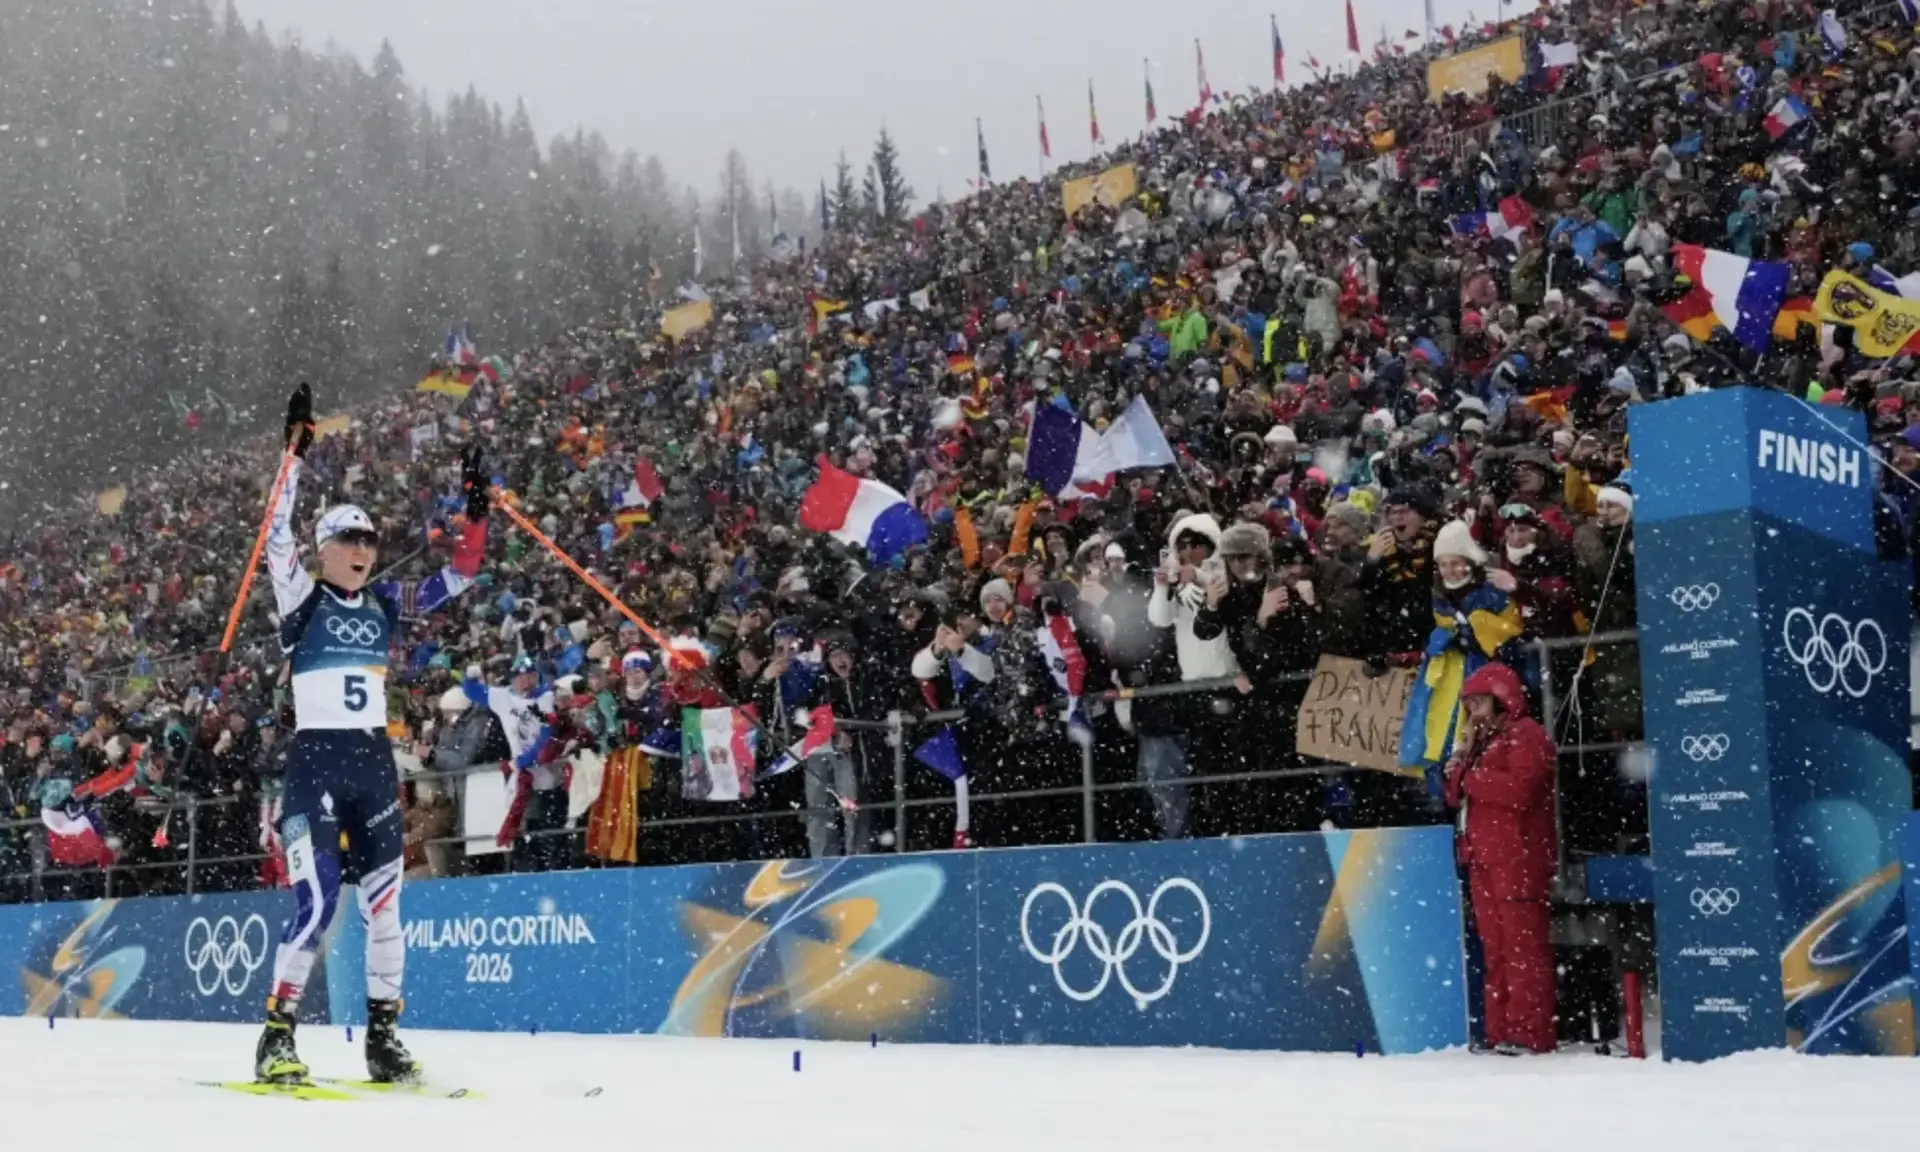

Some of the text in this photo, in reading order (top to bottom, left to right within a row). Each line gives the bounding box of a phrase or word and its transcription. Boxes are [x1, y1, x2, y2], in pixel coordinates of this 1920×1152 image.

[1758, 429, 1859, 488] FINISH
[343, 674, 368, 712] 5
[291, 849, 302, 870] 5
[403, 914, 596, 948] MILANO CORTINA
[466, 952, 512, 983] 2026
